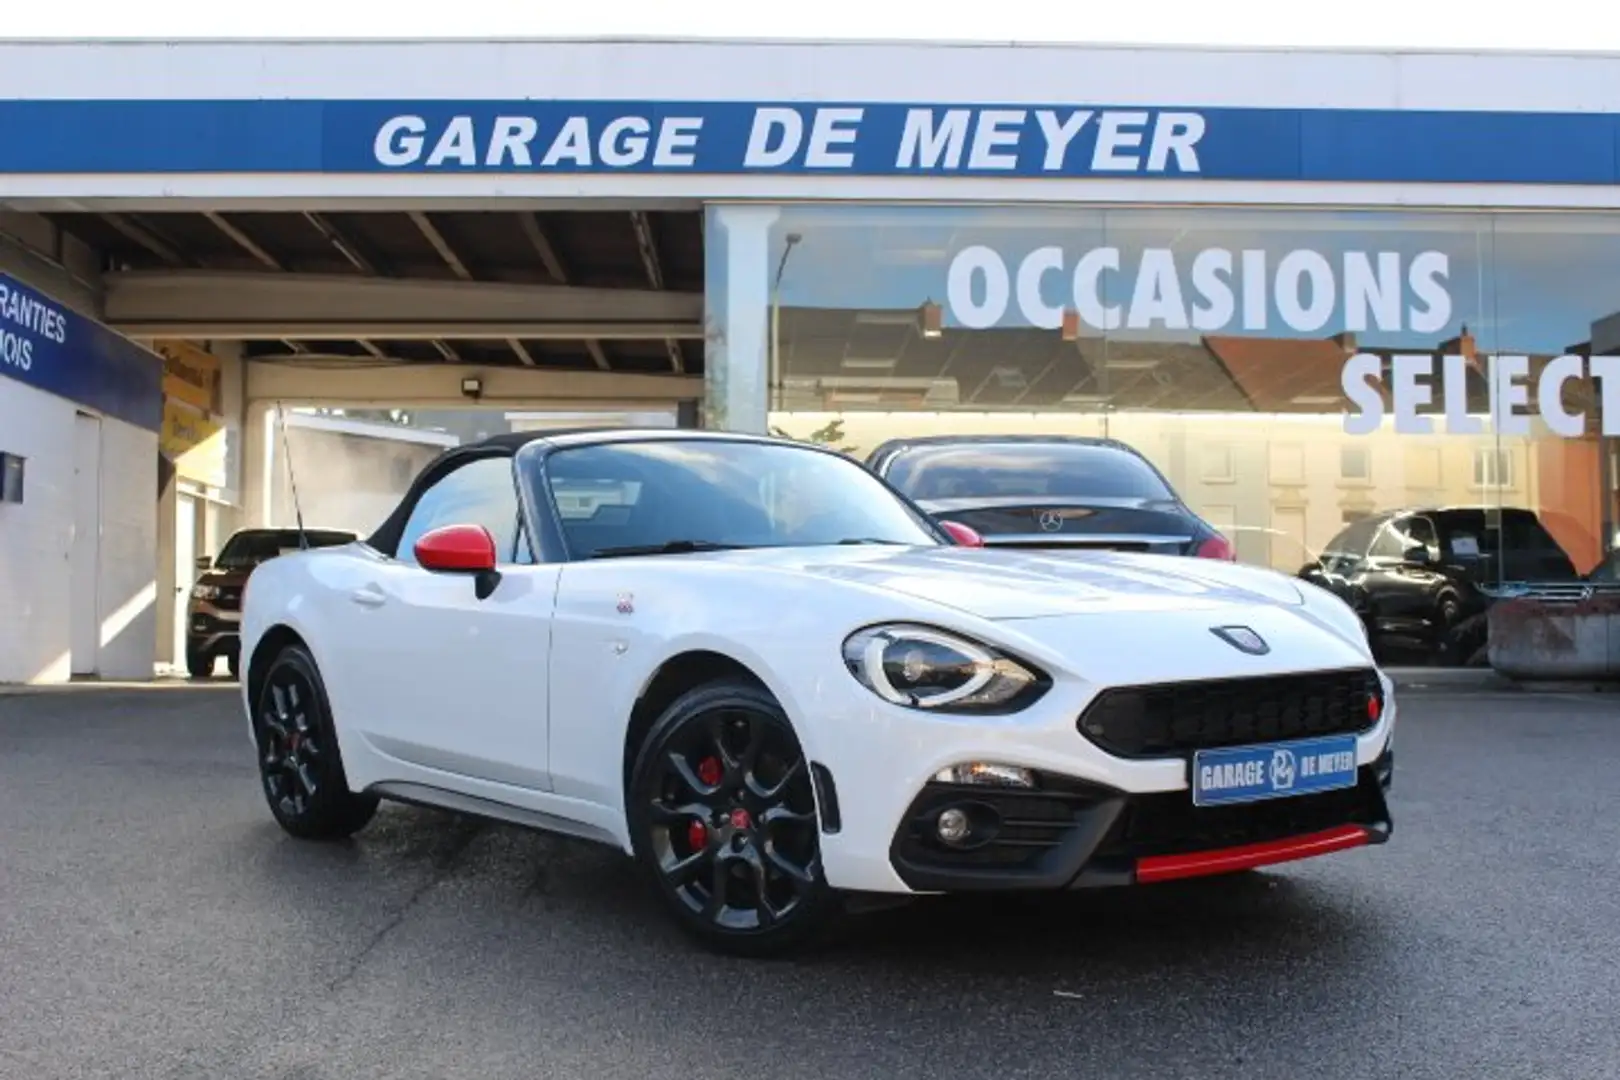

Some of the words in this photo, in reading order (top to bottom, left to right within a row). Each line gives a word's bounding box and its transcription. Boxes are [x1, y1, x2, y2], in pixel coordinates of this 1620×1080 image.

[373, 115, 704, 167] GARAGE
[743, 107, 865, 168] DE
[895, 108, 1206, 173] MEYER
[947, 246, 1451, 333] OCCASIONS
[1342, 354, 1620, 438] SELECT
[1201, 760, 1265, 790] GARAGE
[1301, 756, 1317, 777] DE
